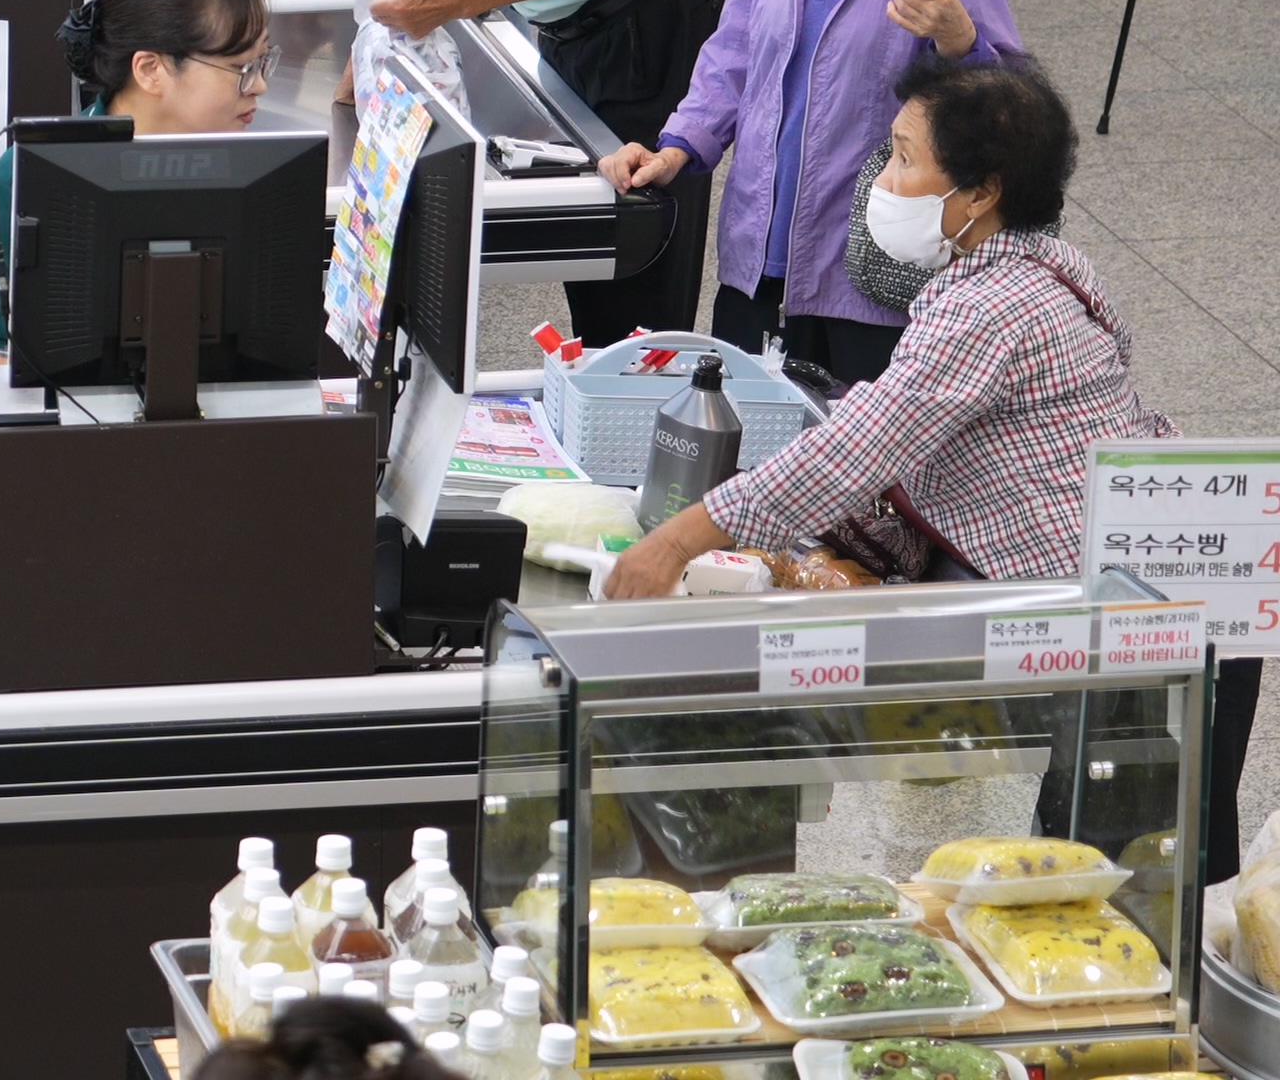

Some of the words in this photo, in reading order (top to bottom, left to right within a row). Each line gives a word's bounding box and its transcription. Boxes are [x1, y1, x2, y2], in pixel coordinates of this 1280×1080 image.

[655, 428, 700, 457] KERASYS
[1108, 474, 1193, 498] 옥수수
[1203, 473, 1248, 497] 4개
[1103, 532, 1228, 557] 옥수수빵
[1143, 562, 1206, 578] 천연발효시켜
[1208, 562, 1229, 577] 만든
[1232, 561, 1254, 577] 술빵
[990, 620, 1049, 637] 옥수수빵
[1118, 629, 1190, 647] 계산대에서
[1206, 620, 1225, 636] 만든
[1228, 620, 1250, 636] 술빵
[1017, 650, 1086, 675] 4,000
[1107, 648, 1136, 664] 이용
[1140, 644, 1199, 663] 바랍니다
[789, 665, 860, 690] 5,000
